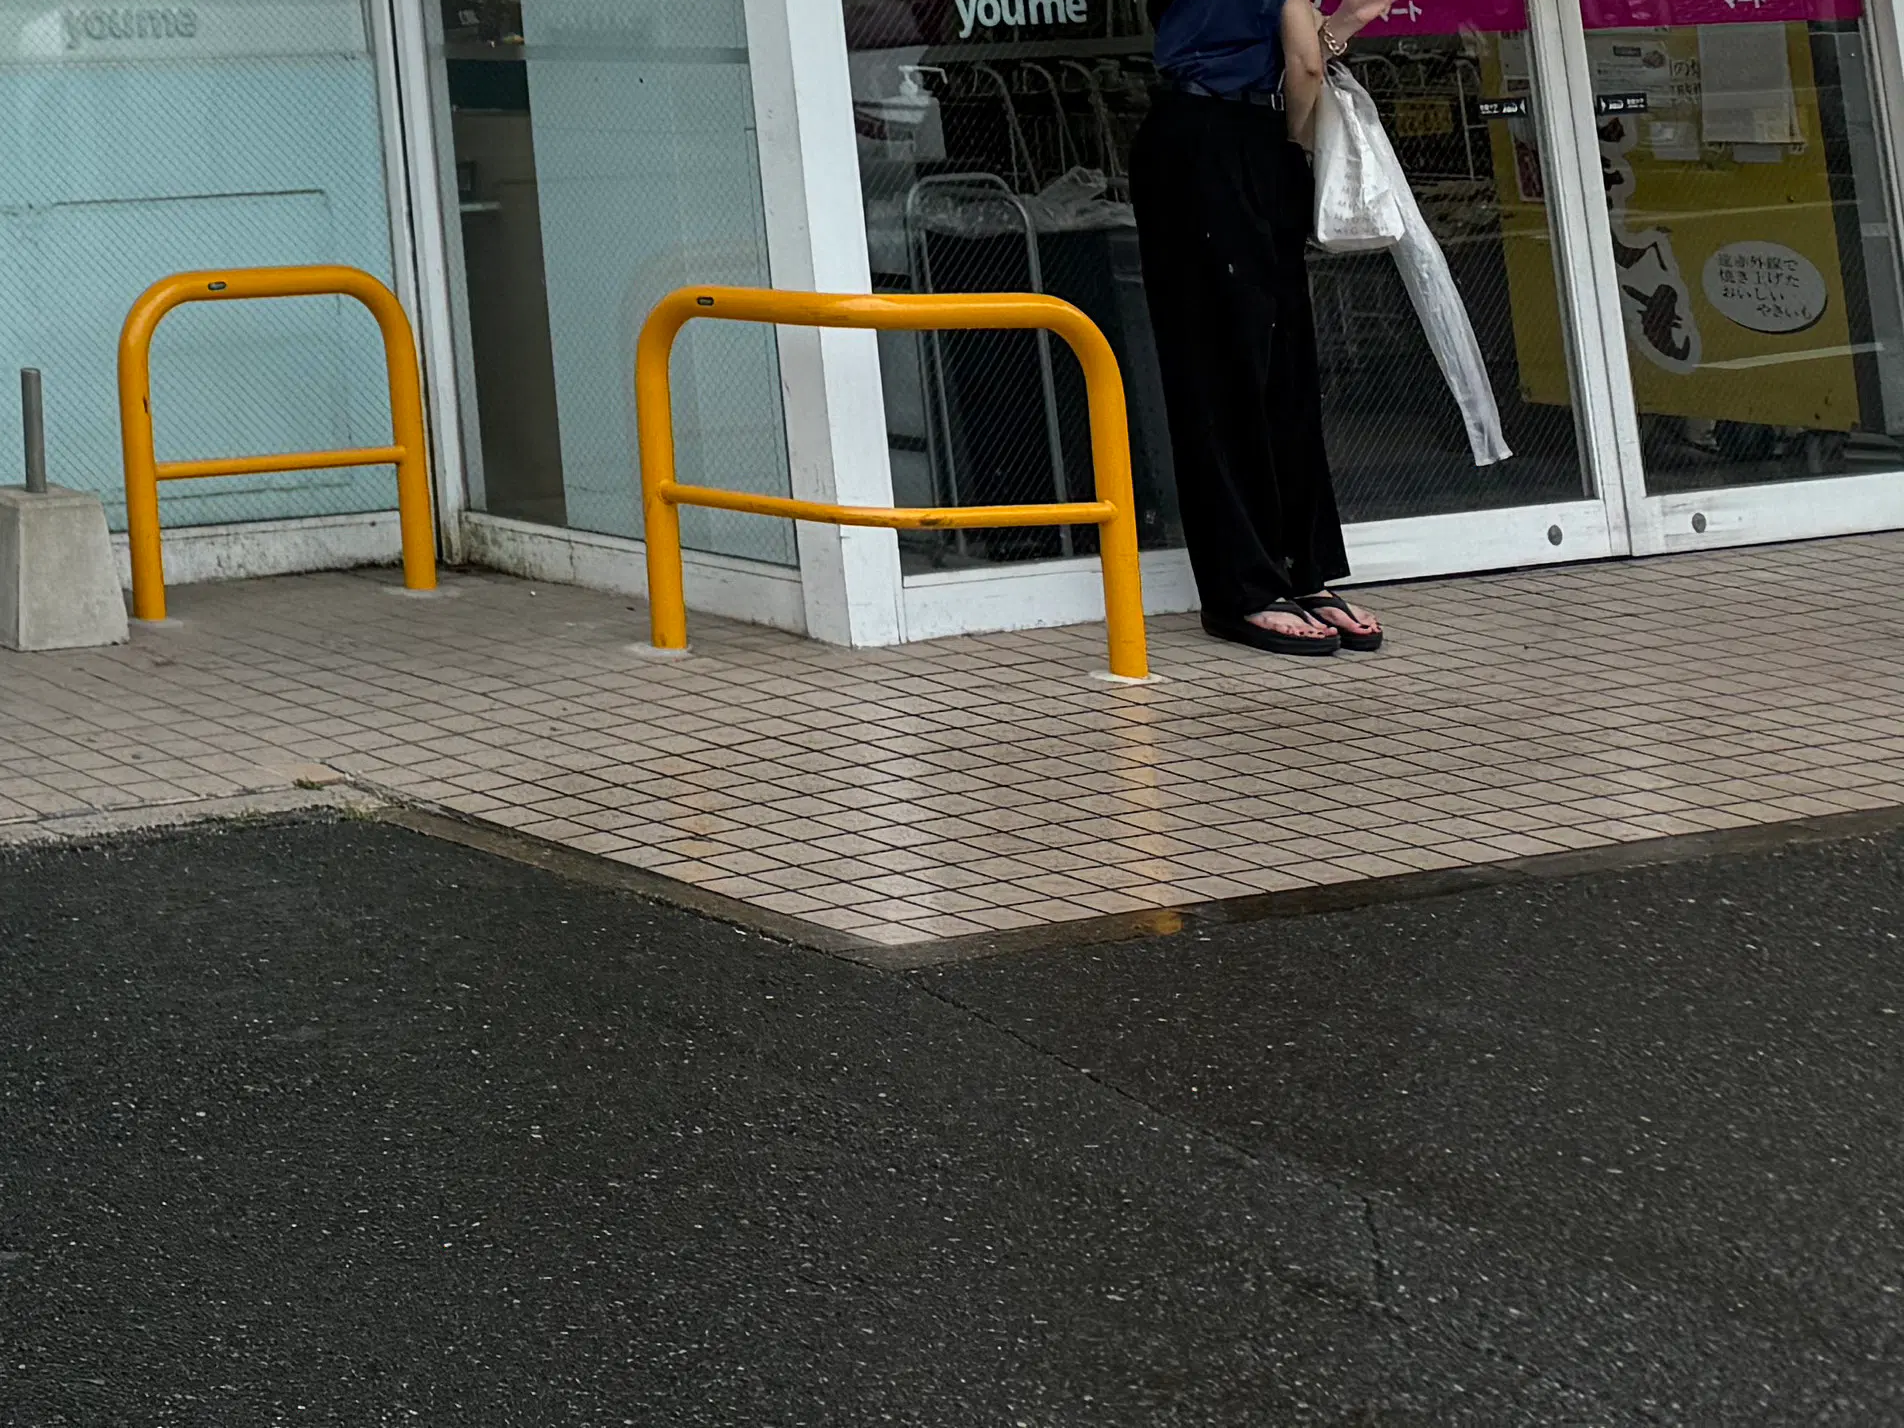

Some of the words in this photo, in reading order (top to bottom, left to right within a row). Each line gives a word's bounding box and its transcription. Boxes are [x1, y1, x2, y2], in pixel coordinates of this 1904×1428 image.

[61, 1, 198, 51] youme
[1722, 286, 1785, 301] おいしい
